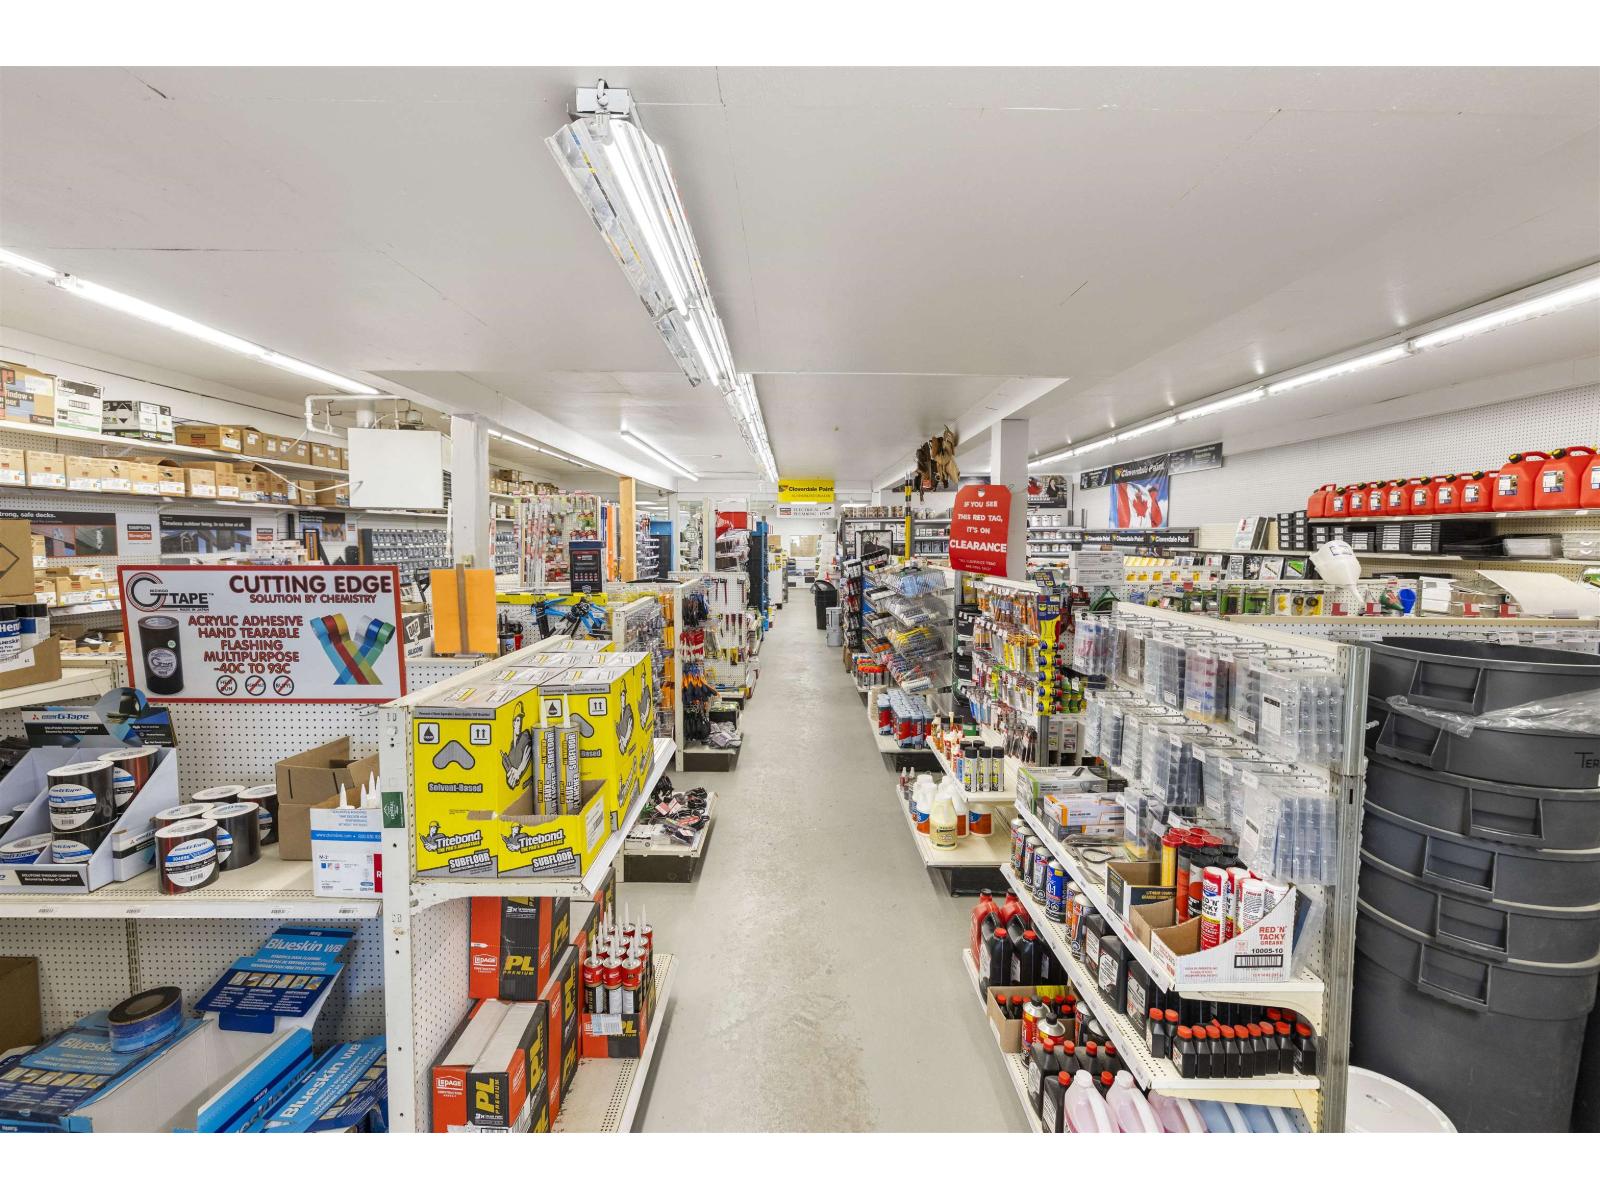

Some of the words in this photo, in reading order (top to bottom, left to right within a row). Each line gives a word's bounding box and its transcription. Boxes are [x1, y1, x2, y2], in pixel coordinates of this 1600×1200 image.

[1149, 462, 1164, 473] Paint
[988, 515, 1003, 523] TAG,
[950, 540, 1007, 552] CLEARANCE
[229, 575, 326, 593] CUTTING
[335, 575, 392, 594] EDGE
[169, 593, 208, 604] TAPE
[250, 594, 302, 604] SOLUTION
[304, 594, 317, 604] BY
[320, 594, 377, 604] CHEMISTRY
[188, 616, 238, 626] ACRYLIC
[242, 616, 303, 626] ADHESIVE
[198, 628, 236, 638] HAND
[240, 628, 300, 638] TEARABLE
[408, 621, 419, 637] DAP
[221, 640, 283, 650] FLASHING
[408, 646, 423, 656] SILICONE
[204, 652, 300, 662] MULTIPURPOSE
[214, 663, 245, 674] -40C
[248, 663, 264, 674] TO
[268, 663, 291, 674] 93C
[428, 783, 482, 792] Solvent-Based
[436, 831, 480, 847] Titebond
[519, 830, 563, 847] Titebond
[449, 852, 490, 868] SUBFLOOR
[533, 852, 574, 868] SUBFLOOR
[266, 938, 323, 952] Blueskin
[324, 943, 344, 953] WB
[504, 955, 534, 971] PL
[58, 1038, 112, 1052] Bluesk
[279, 1062, 344, 1118] Blueskin
[342, 1043, 361, 1060] WB
[476, 1078, 495, 1113] PL
